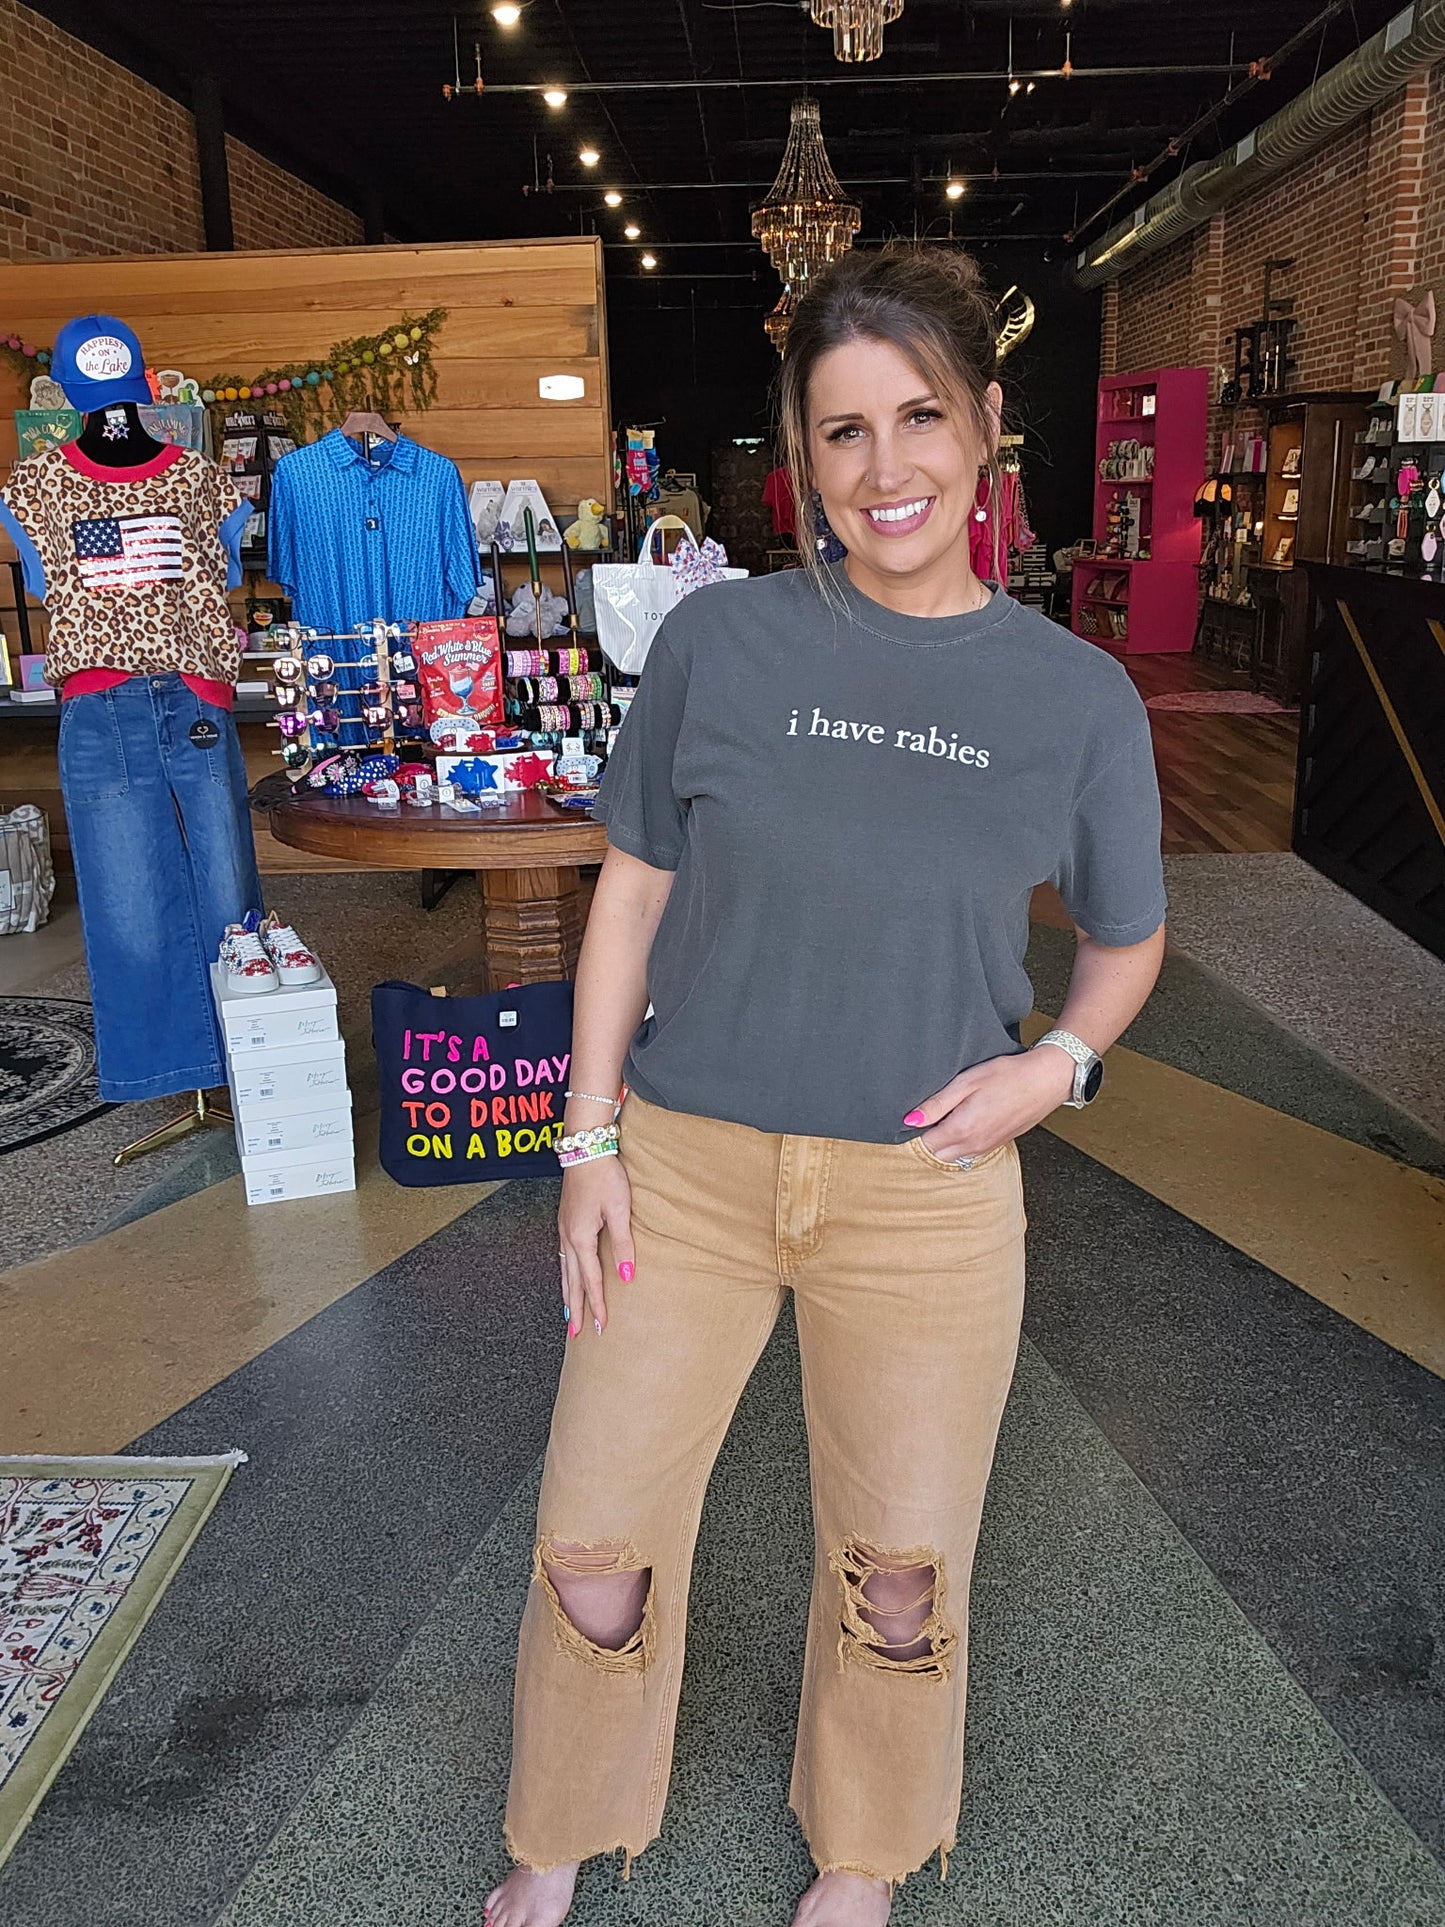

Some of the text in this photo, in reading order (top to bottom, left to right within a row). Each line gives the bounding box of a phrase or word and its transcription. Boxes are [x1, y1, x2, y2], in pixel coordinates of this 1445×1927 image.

[80, 338, 124, 355] HAPPIEST
[85, 358, 128, 375] the Lake
[421, 640, 493, 665] Red White & Blue
[443, 652, 489, 666] Summer
[786, 707, 990, 769] i have rabies
[403, 1029, 490, 1062] IT'S A
[401, 1053, 571, 1094] GOOD DAY
[401, 1091, 554, 1129] TO DRINK
[406, 1122, 565, 1159] ON A BOAT
